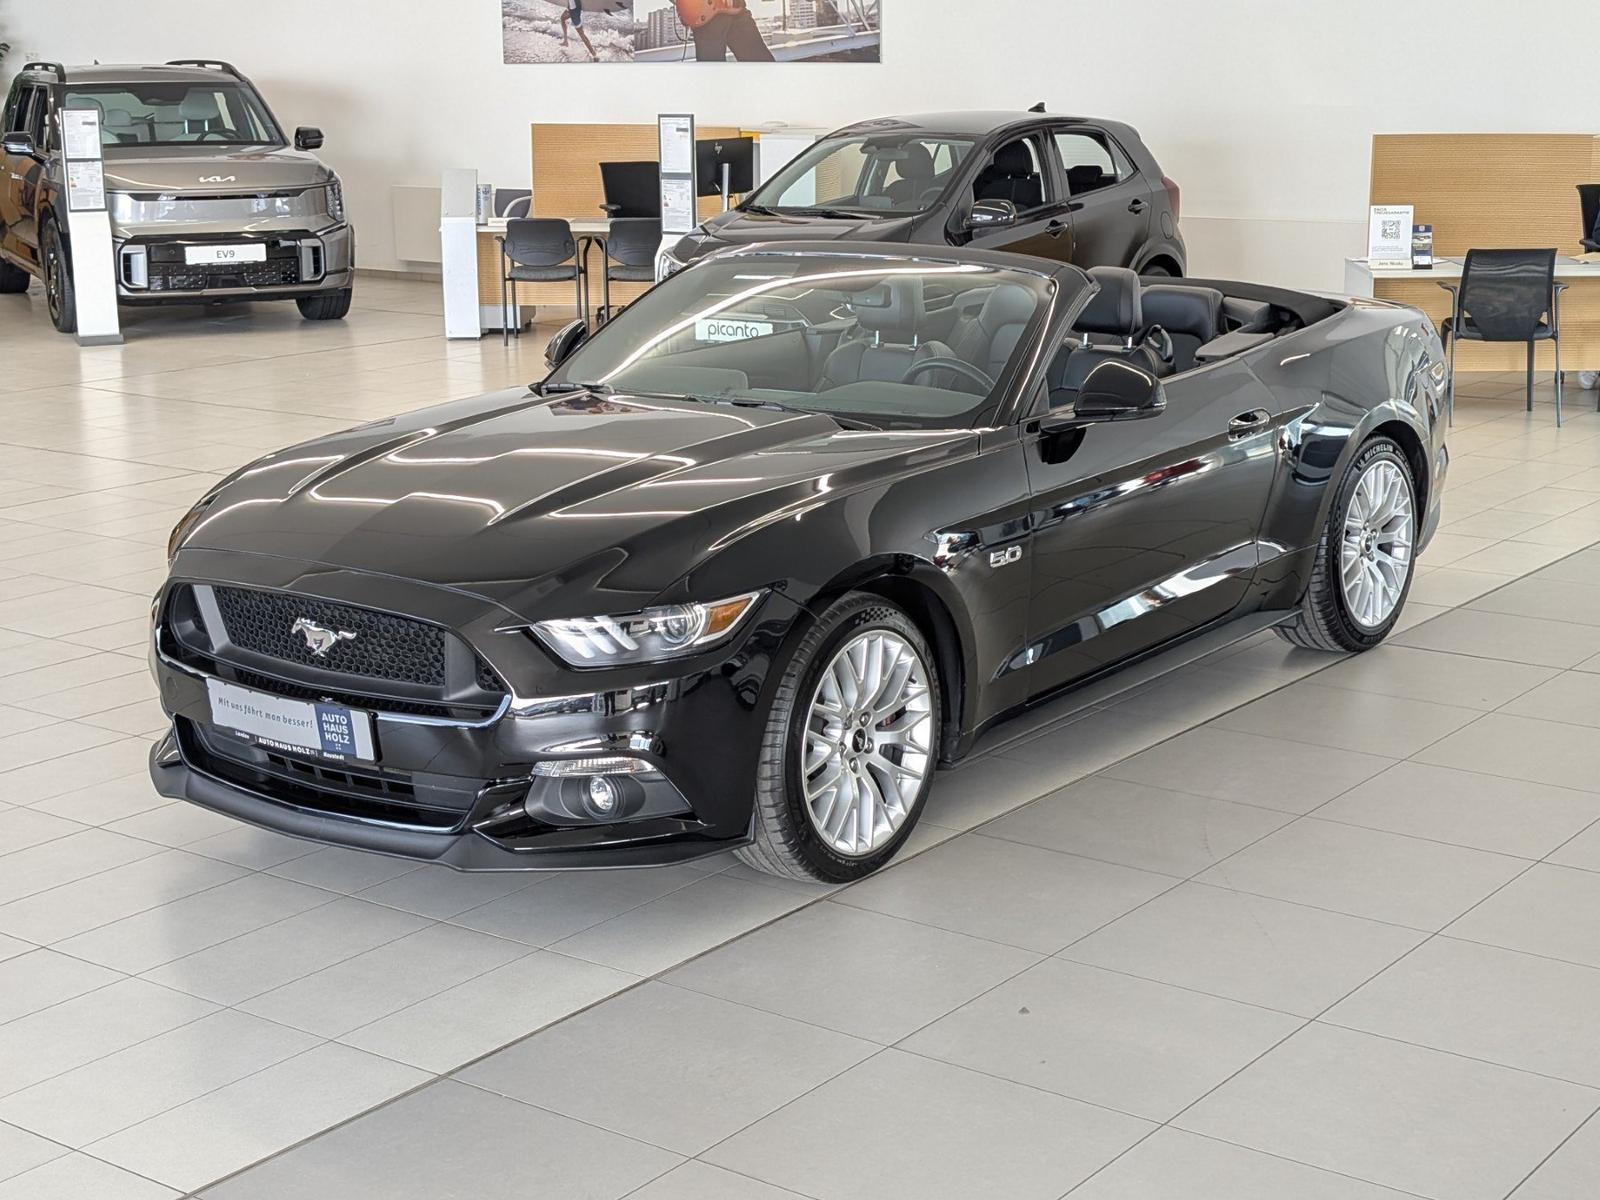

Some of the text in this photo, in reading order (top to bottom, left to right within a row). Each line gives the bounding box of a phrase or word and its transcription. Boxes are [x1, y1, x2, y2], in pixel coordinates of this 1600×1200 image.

[216, 249, 235, 259] EV9
[707, 321, 759, 340] picanto
[1363, 443, 1394, 461] MICHELIN
[218, 696, 230, 708] Mit
[230, 702, 244, 712] uns
[265, 711, 281, 721] man
[282, 714, 313, 729] besser!
[321, 712, 348, 724] AUTO
[323, 721, 349, 735] HAUS
[325, 732, 350, 745] HOLZ
[292, 744, 310, 755] HOLZ
